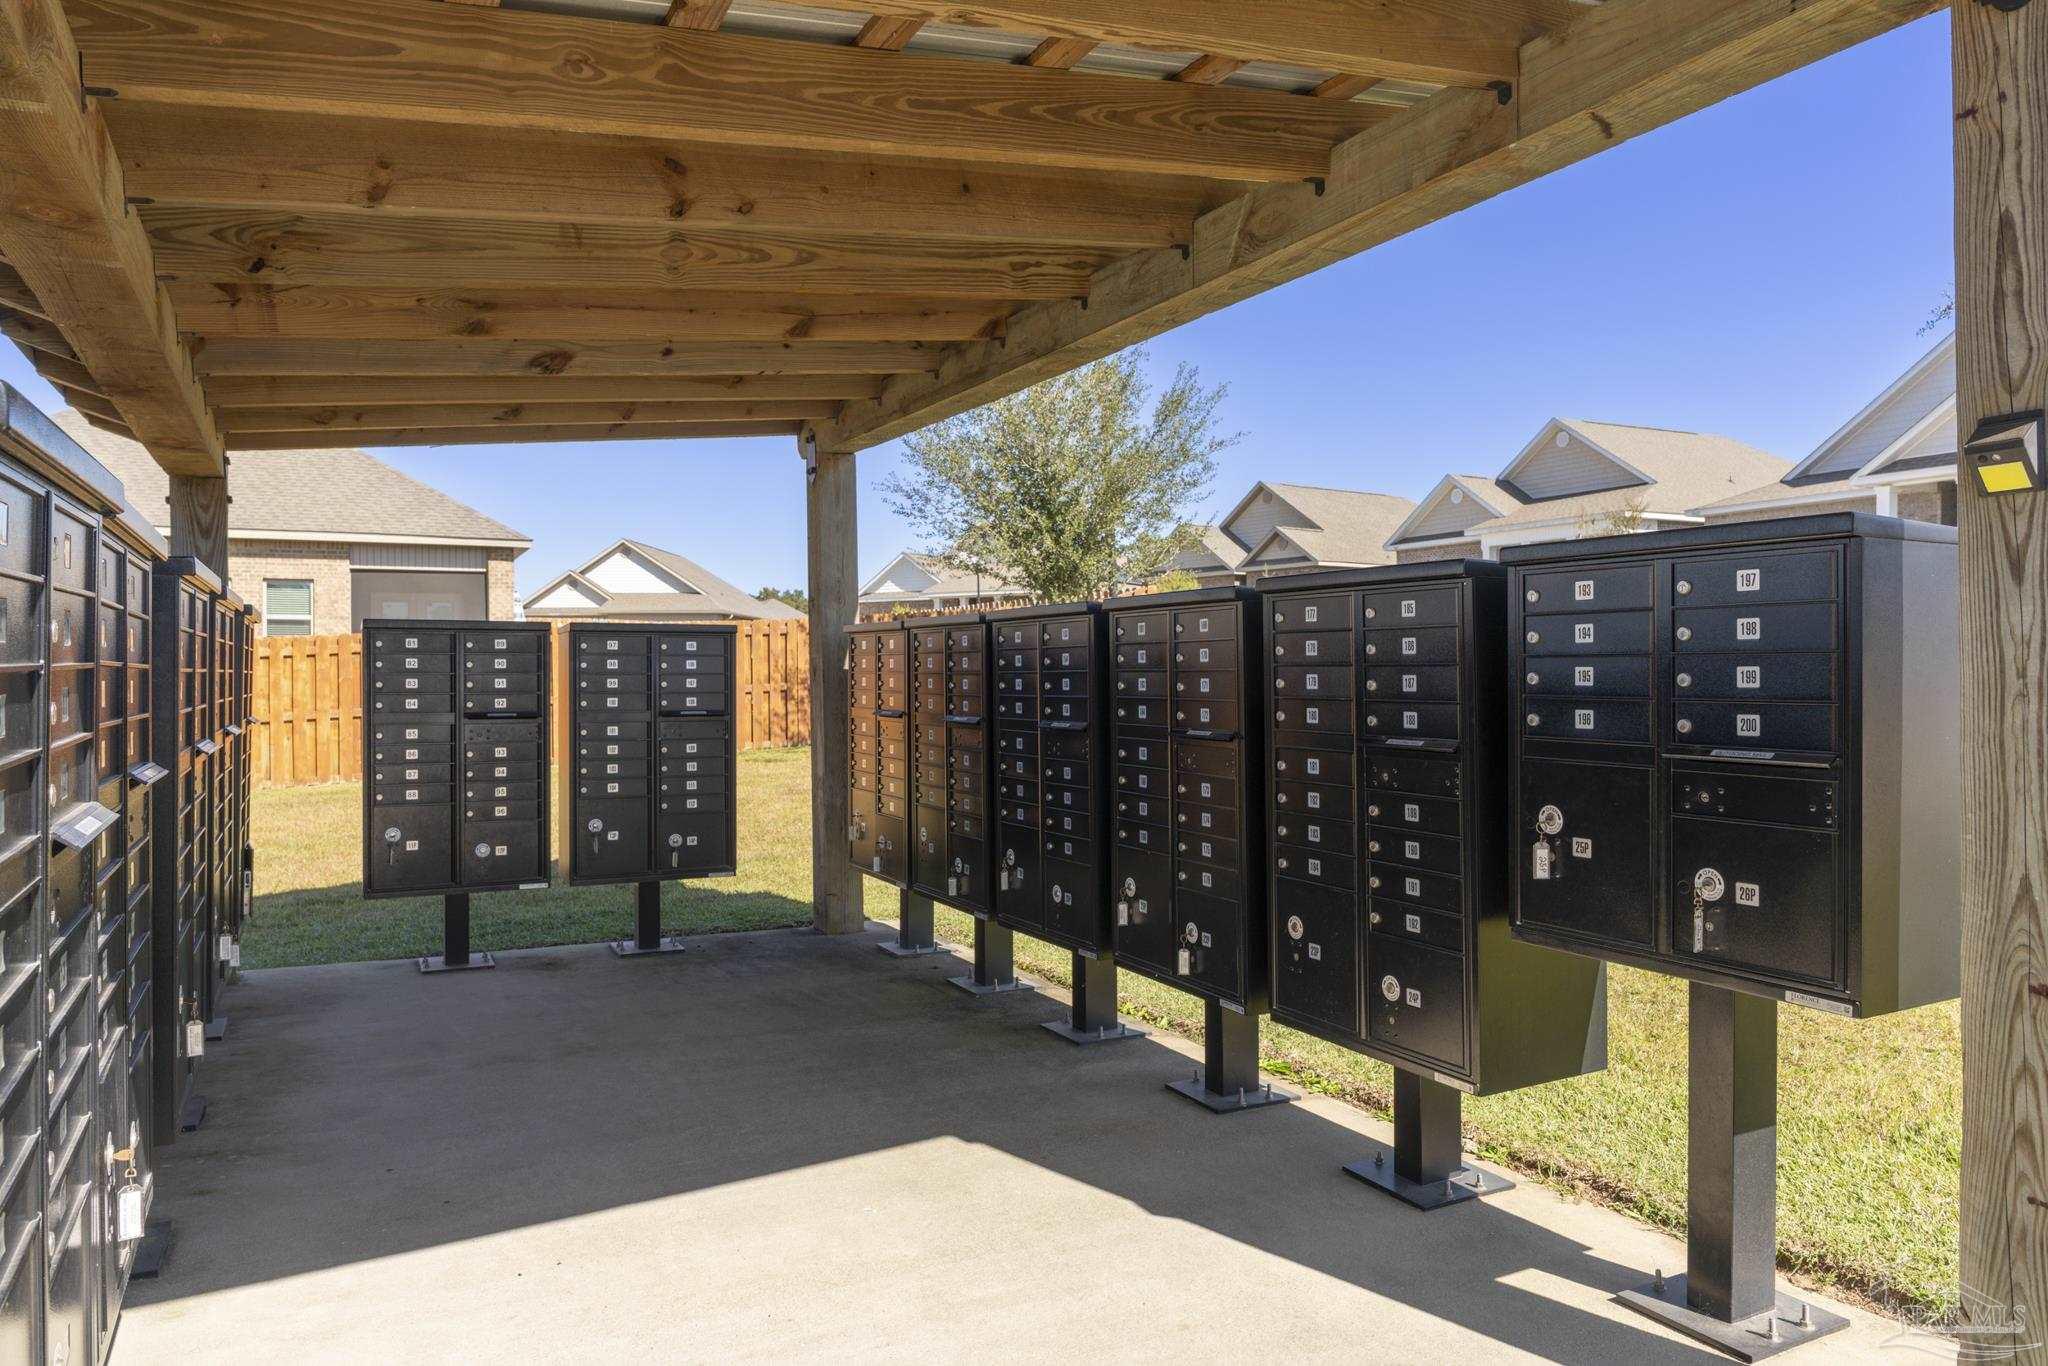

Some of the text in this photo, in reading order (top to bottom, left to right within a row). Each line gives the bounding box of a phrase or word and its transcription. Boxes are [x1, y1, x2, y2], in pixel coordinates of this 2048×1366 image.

[1740, 572, 1757, 588] 197
[1578, 583, 1592, 597] 193
[1306, 608, 1316, 620] 177
[1403, 602, 1414, 615] 185
[1577, 626, 1592, 640] 194
[1740, 621, 1758, 636] 198
[1577, 669, 1592, 683] 195
[1740, 669, 1757, 684] 199
[1404, 677, 1415, 690] 187
[1405, 714, 1416, 726] 188
[1578, 712, 1592, 726] 196
[1740, 717, 1757, 733] 200
[1575, 840, 1590, 854] 25P
[1408, 880, 1418, 894] 191
[1739, 886, 1756, 902] 26P
[1408, 917, 1419, 930] 192
